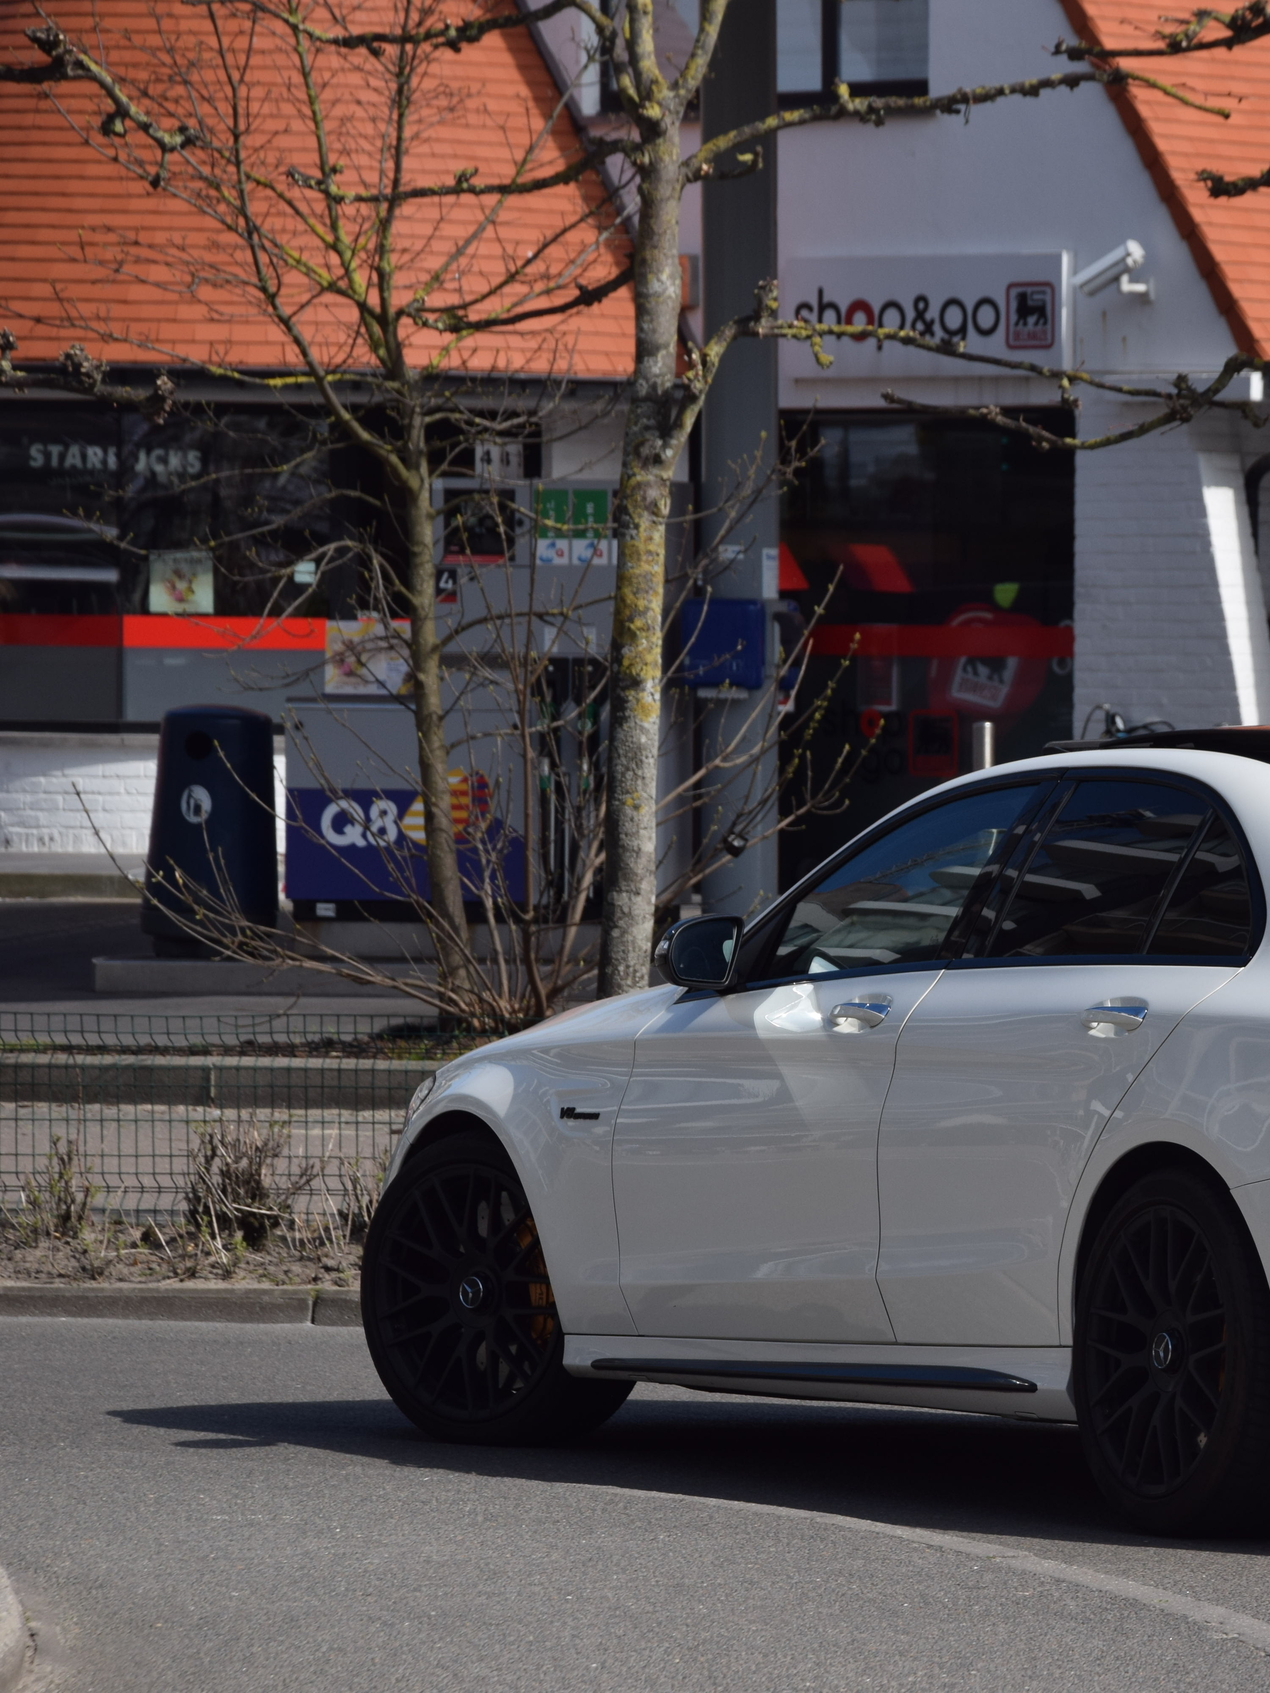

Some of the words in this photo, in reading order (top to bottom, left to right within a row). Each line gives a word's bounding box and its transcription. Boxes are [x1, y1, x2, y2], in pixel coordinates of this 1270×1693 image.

[794, 286, 1000, 352] shop&go
[438, 571, 454, 589] 4
[320, 799, 399, 848] Q8
